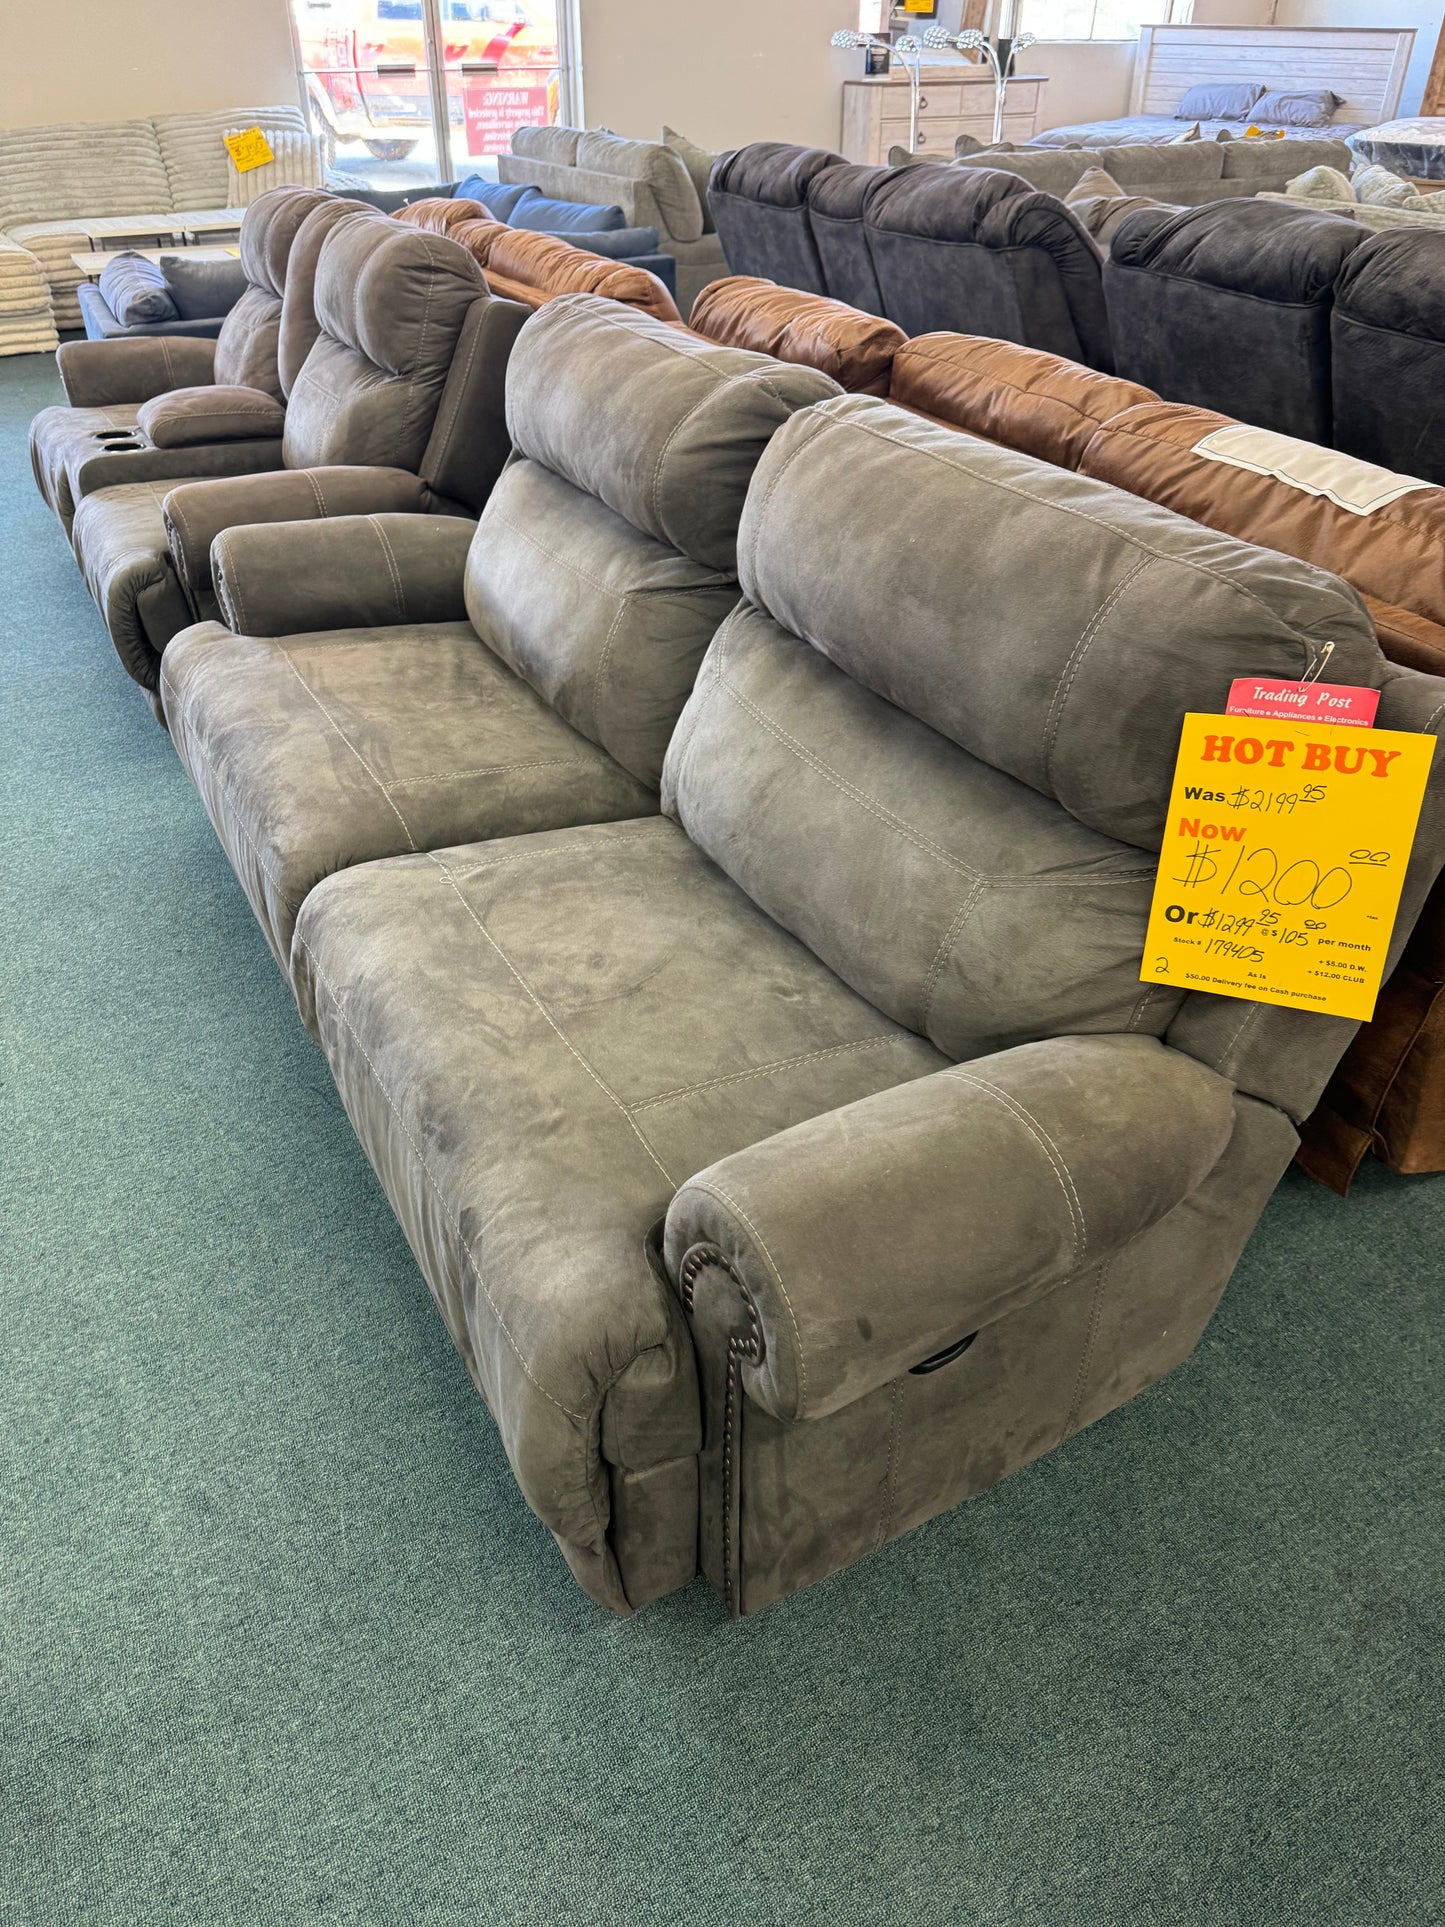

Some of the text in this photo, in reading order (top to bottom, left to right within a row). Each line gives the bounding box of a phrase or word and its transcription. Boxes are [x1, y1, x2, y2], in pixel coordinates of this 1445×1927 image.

[1253, 686, 1352, 708] Trading Post
[1229, 706, 1369, 726] Furniture Appliances Electronics
[1200, 735, 1402, 778] HOT BUY
[1184, 786, 1226, 802] Was
[1178, 818, 1248, 842] Now
[1172, 840, 1353, 910] $1200
[1164, 904, 1200, 925] Or
[1318, 938, 1336, 946] per
[1338, 941, 1372, 952] month
[1173, 936, 1195, 945] Stock
[1204, 938, 1265, 963] 179405
[1155, 956, 1170, 974] 2
[1326, 960, 1348, 969] $5.00
[1185, 972, 1210, 982] $50.00
[1212, 977, 1242, 988] Delivery
[1270, 987, 1289, 996] Cash
[1291, 991, 1327, 1002] purchase
[1314, 970, 1340, 980] $12.00
[1342, 975, 1365, 984] CLUB
